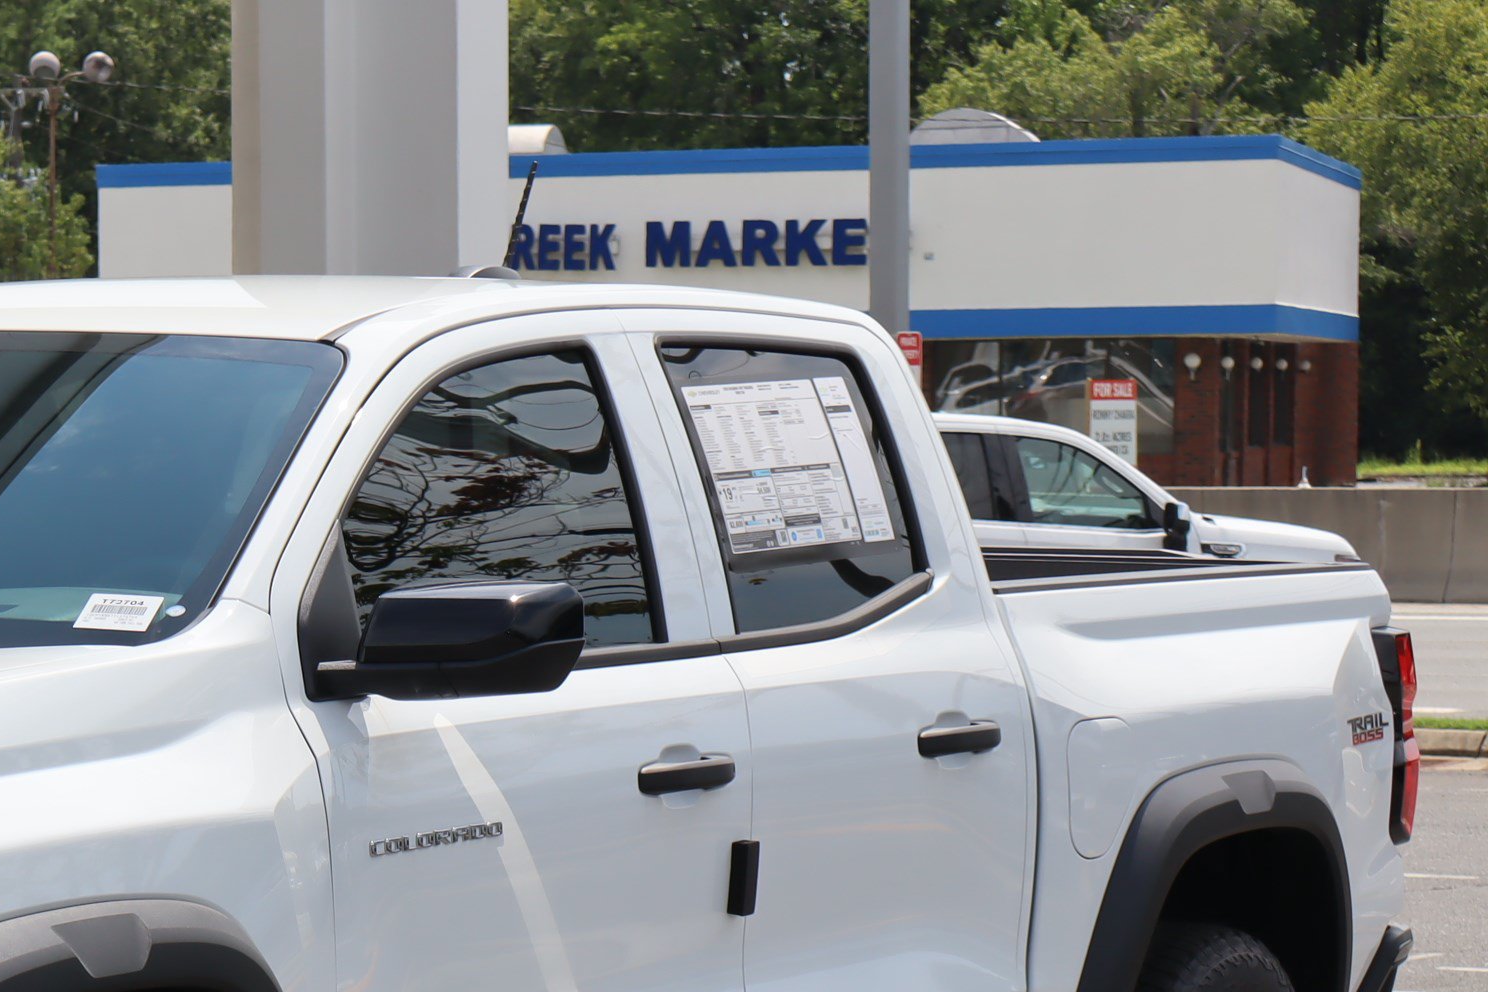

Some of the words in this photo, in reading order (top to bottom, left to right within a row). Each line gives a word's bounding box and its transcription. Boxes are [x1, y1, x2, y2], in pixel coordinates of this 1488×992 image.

[645, 218, 868, 268] MARKE
[1093, 382, 1111, 398] FOR
[1112, 382, 1133, 398] SALE
[102, 598, 145, 606] T72704
[1347, 711, 1389, 734] TRAIL
[1352, 728, 1384, 746] BOSS
[369, 821, 504, 858] COLORADO
